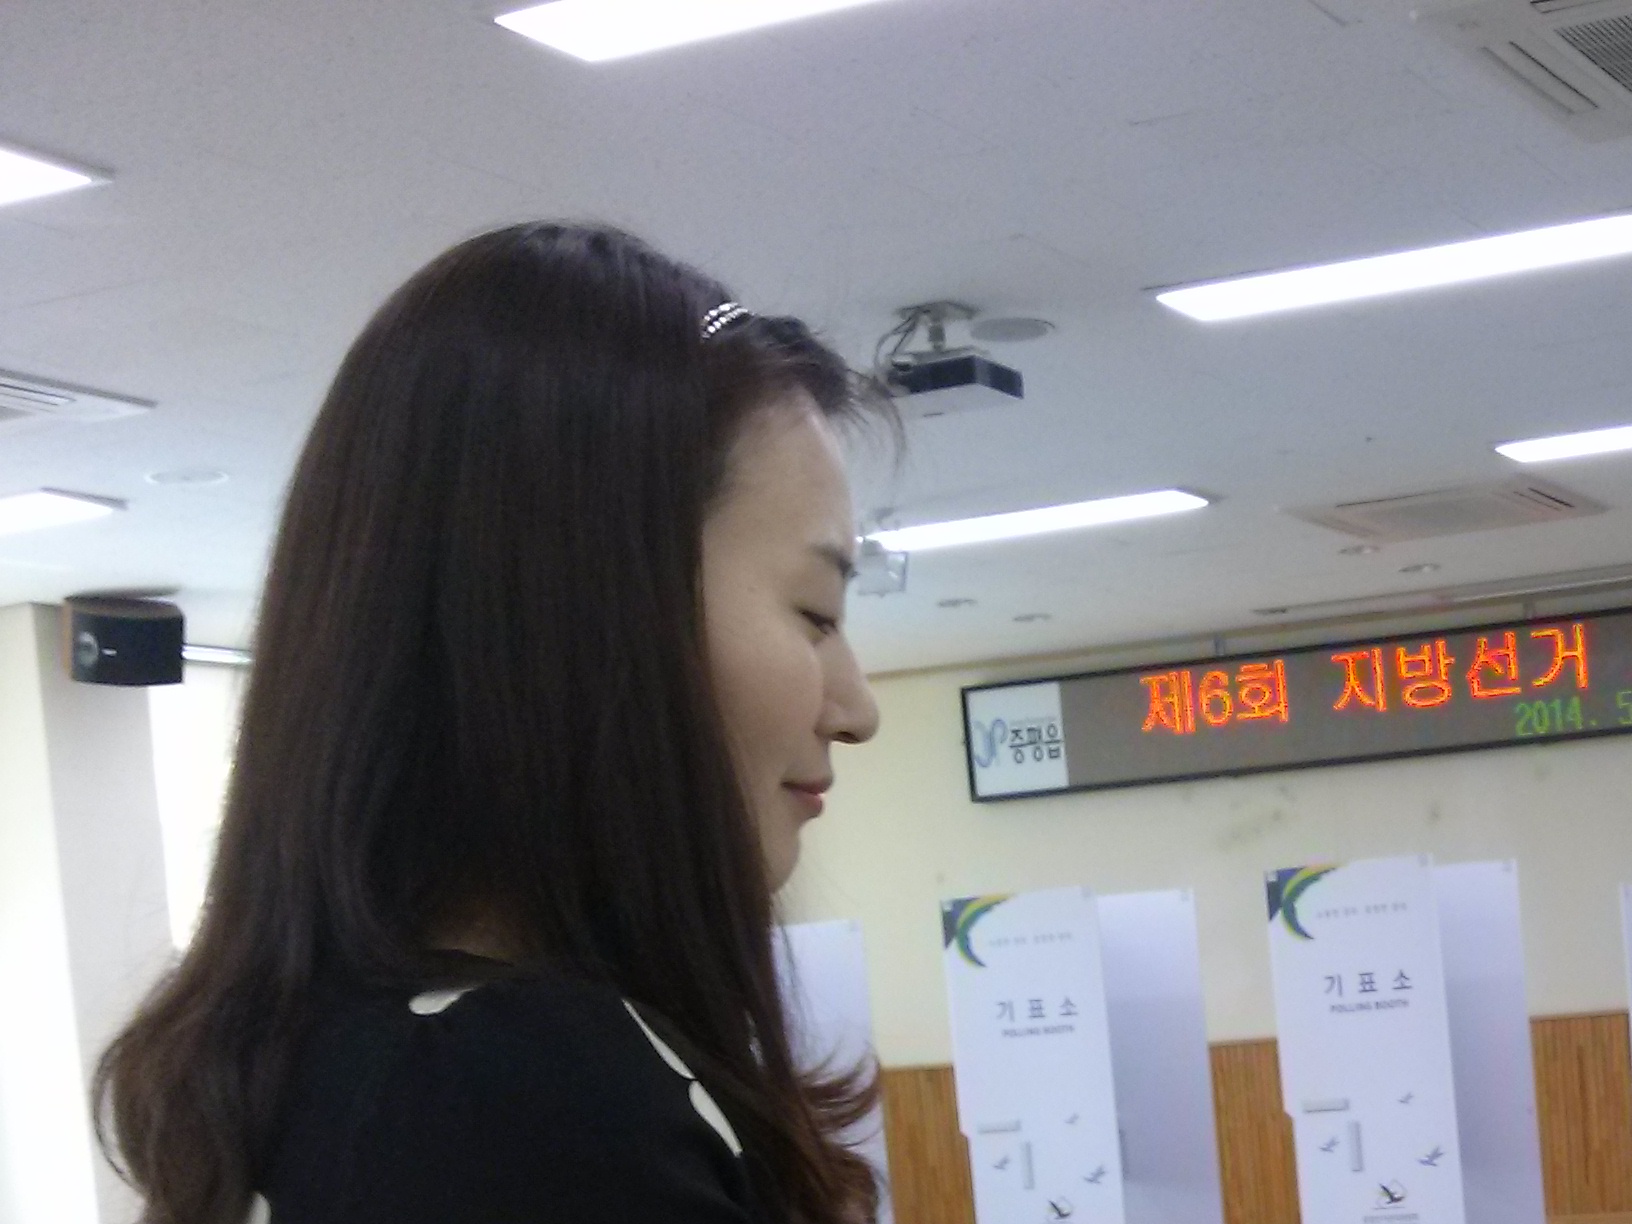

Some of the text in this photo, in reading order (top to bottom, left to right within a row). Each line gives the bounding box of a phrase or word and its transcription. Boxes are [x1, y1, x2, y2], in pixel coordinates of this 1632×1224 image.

[1141, 659, 1288, 735] 제6회
[1331, 623, 1588, 712] 지방선거
[1515, 696, 1597, 736] 2014.
[1008, 722, 1064, 764] 증평읍
[1324, 969, 1413, 998] 기표소
[996, 995, 1079, 1023] 기표소
